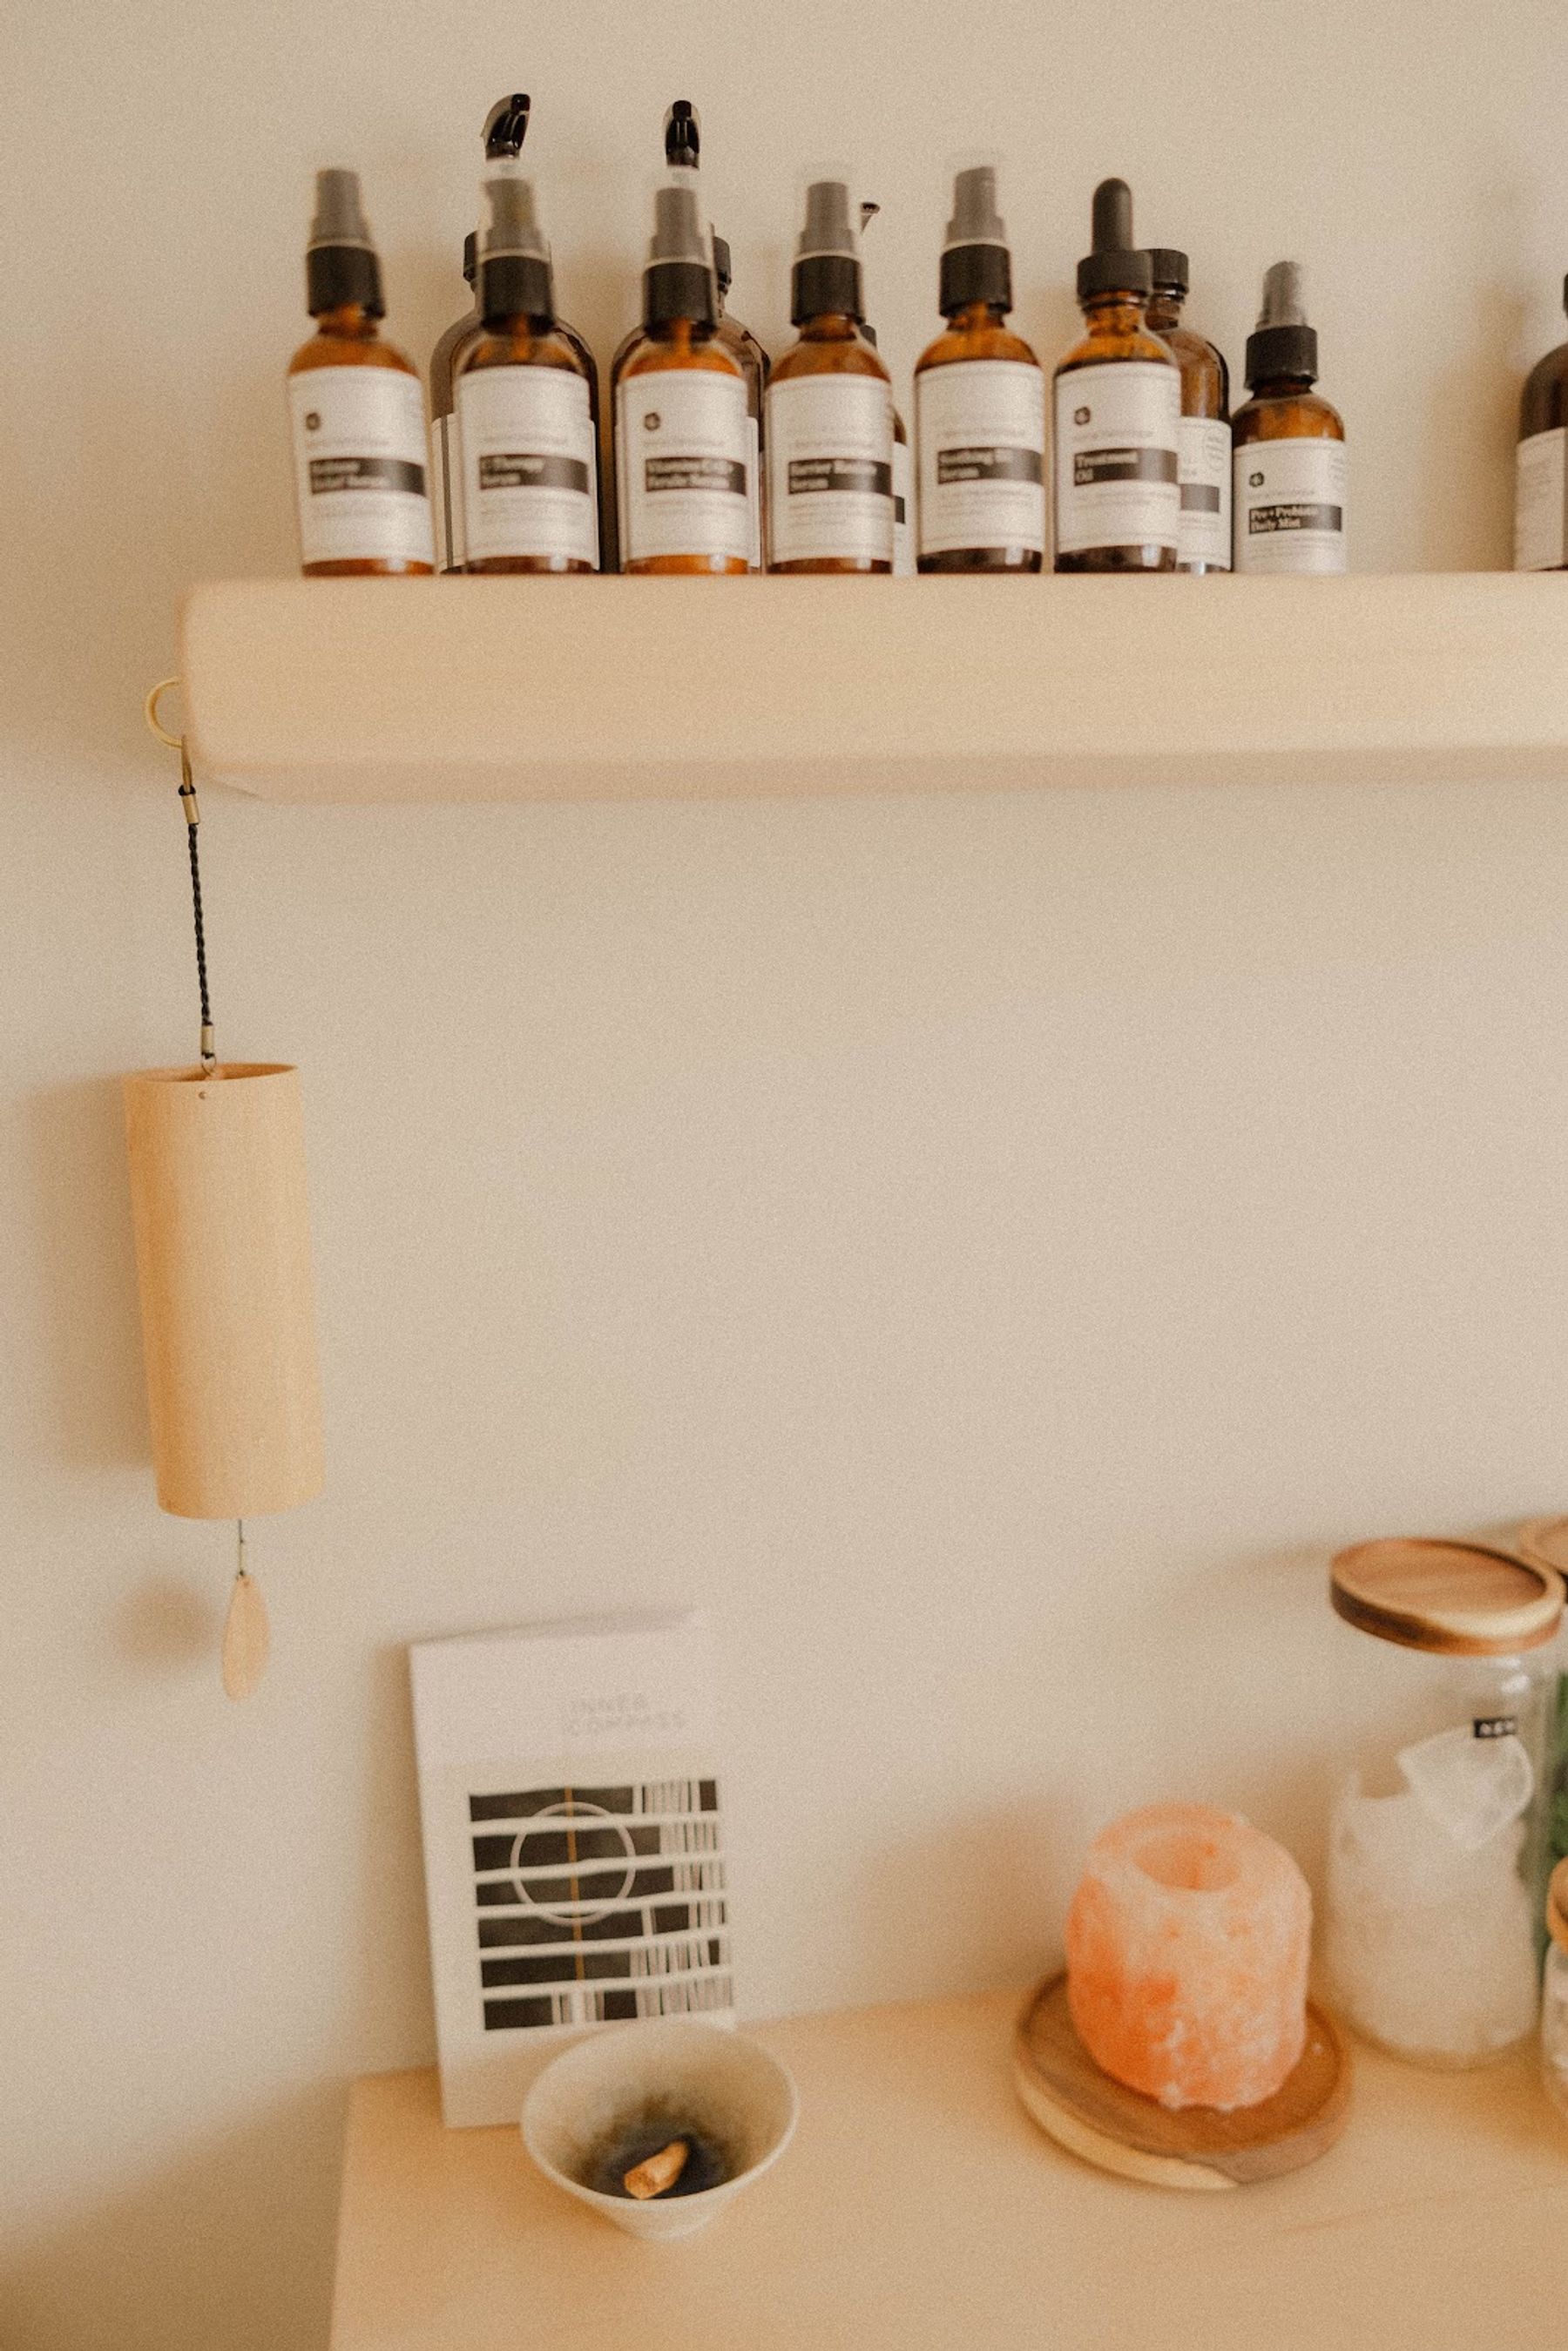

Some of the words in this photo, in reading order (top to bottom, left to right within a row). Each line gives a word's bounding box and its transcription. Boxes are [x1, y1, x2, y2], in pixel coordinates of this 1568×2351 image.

[1077, 451, 1139, 468] Treatment
[1076, 470, 1094, 483] Oil
[1251, 510, 1267, 521] Pre
[1275, 505, 1319, 517] Probiotic
[1251, 519, 1277, 533] Daily
[1278, 518, 1301, 530] Mist
